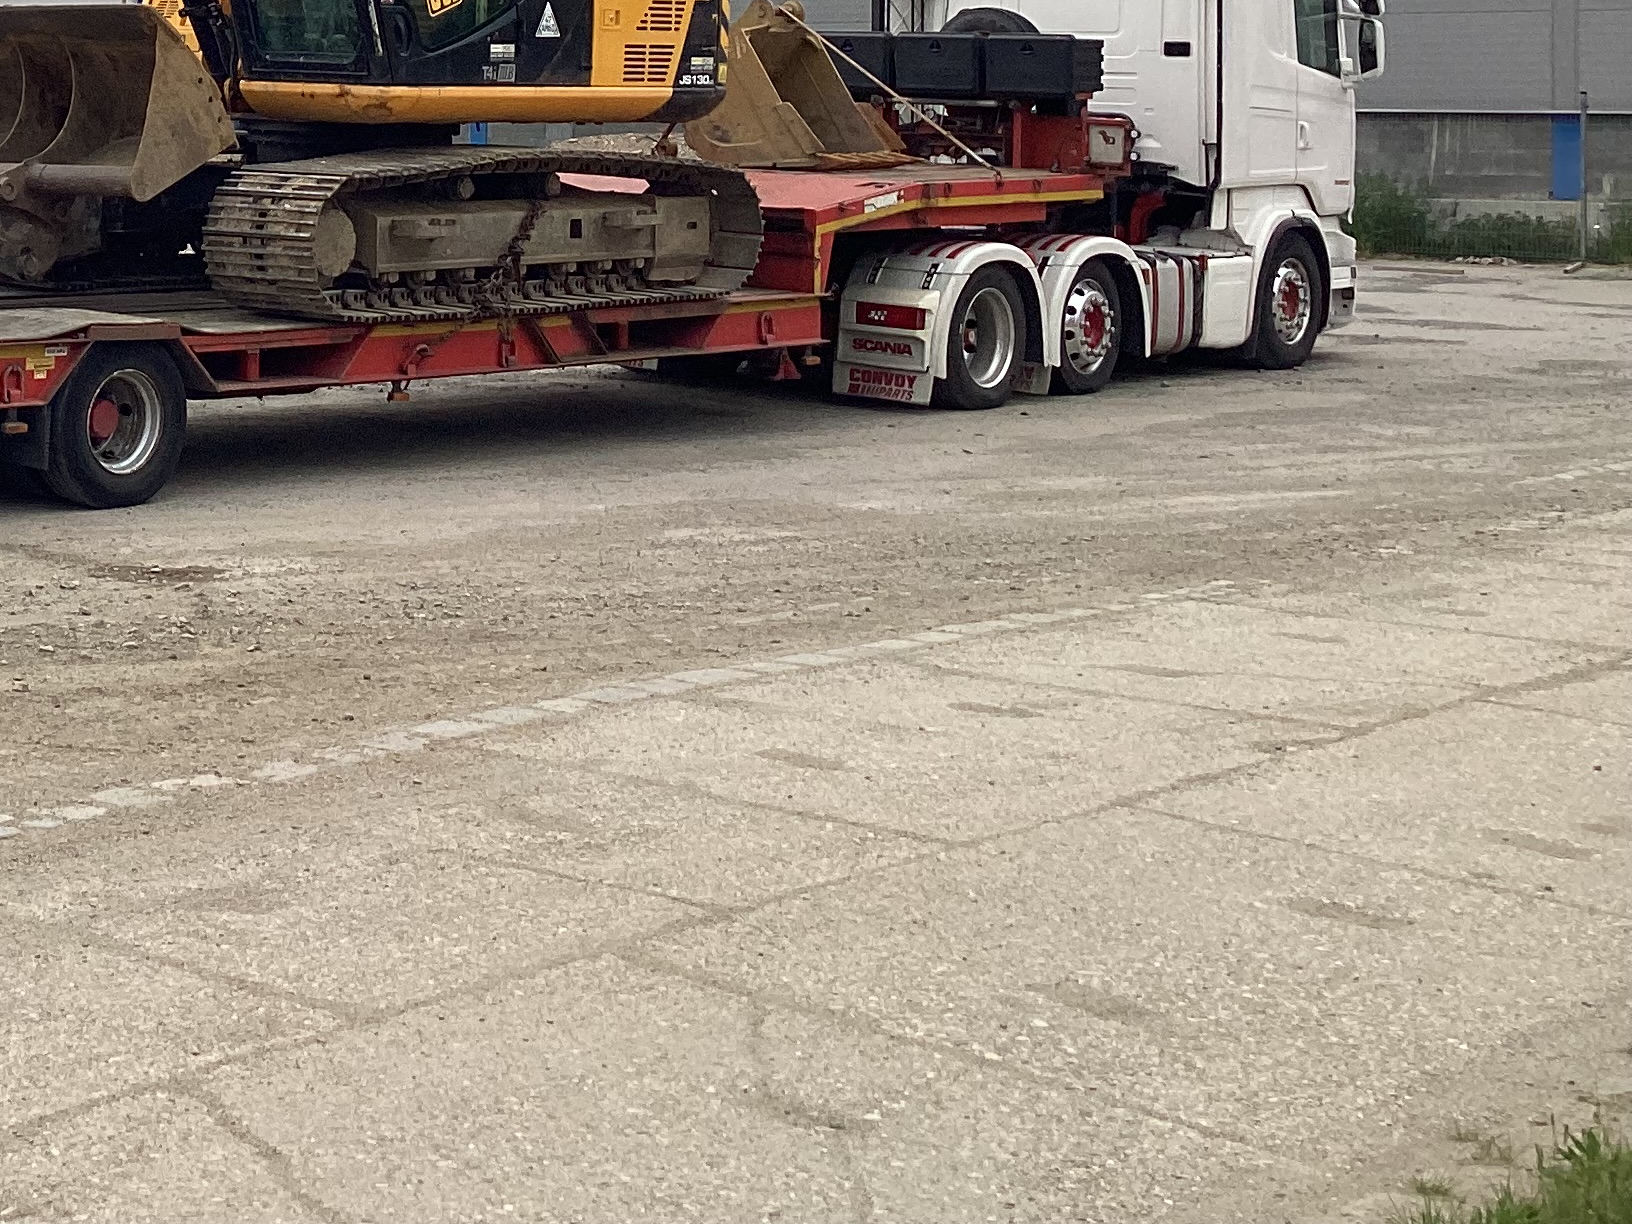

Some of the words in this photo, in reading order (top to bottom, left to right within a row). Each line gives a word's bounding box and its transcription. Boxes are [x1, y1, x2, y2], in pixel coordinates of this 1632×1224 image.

[678, 74, 710, 85] JS130
[852, 337, 913, 356] SCANIA
[849, 368, 917, 389] CONVOY
